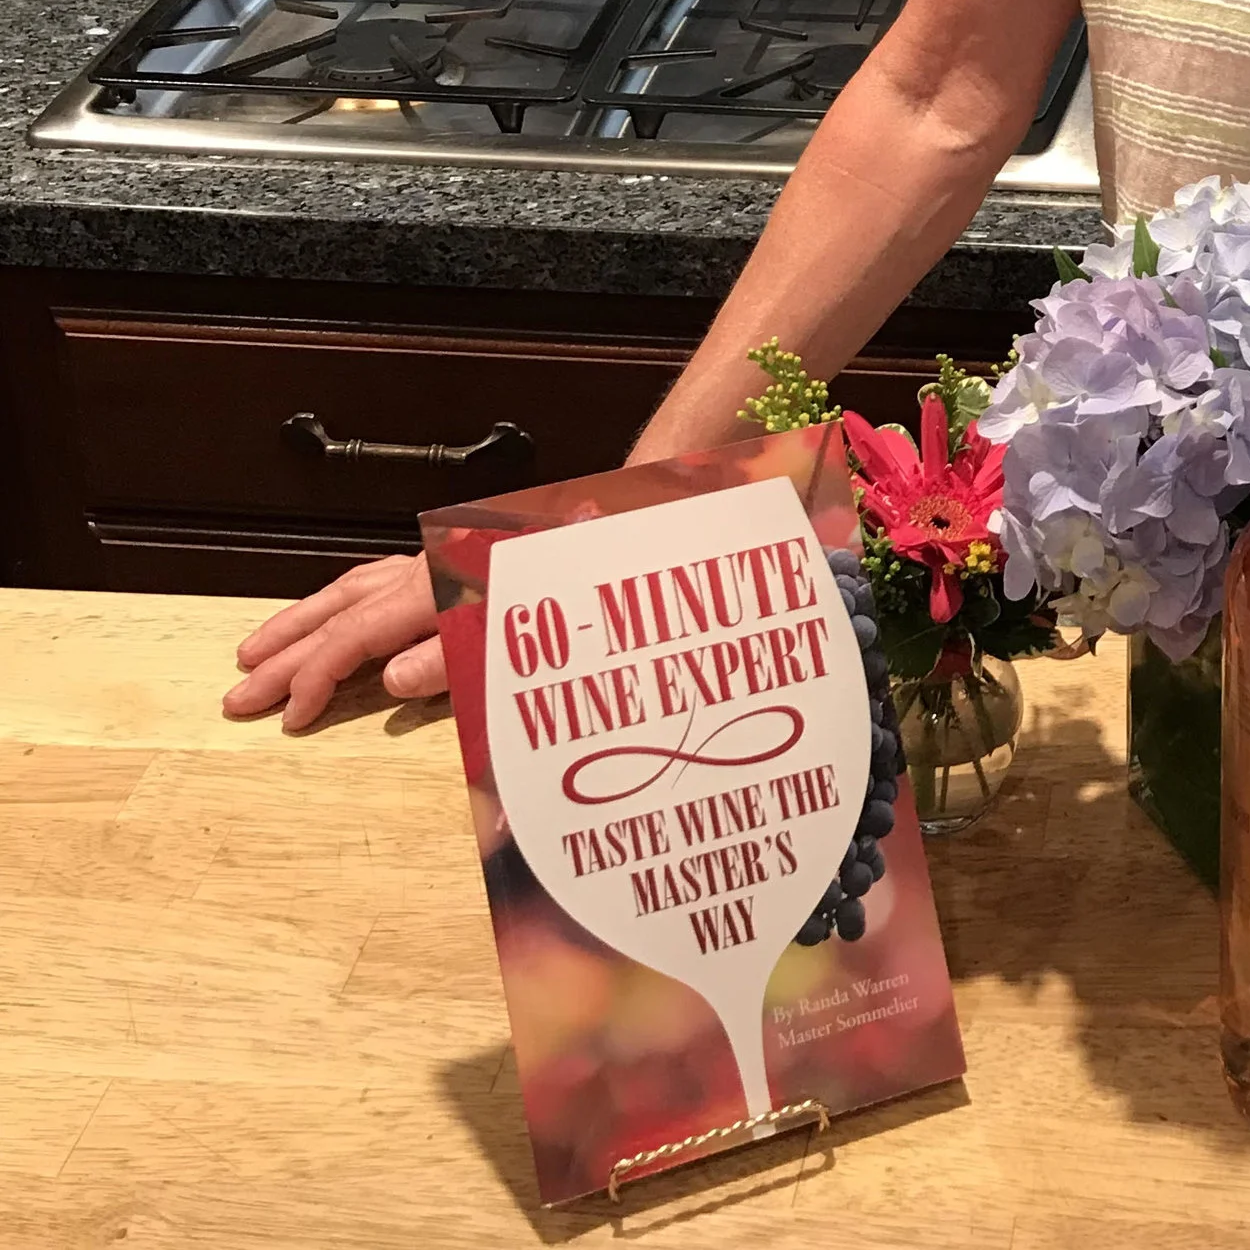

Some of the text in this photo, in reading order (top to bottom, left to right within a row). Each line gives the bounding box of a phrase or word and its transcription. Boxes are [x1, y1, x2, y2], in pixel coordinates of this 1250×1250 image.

[512, 617, 830, 751] WINE EXPERT
[562, 764, 840, 879] TASTE WINE THE
[628, 829, 798, 919] MASTER'S
[688, 895, 757, 955] WAY
[772, 972, 909, 1028] By Randa Warren
[777, 995, 920, 1049] Master Sommelier
